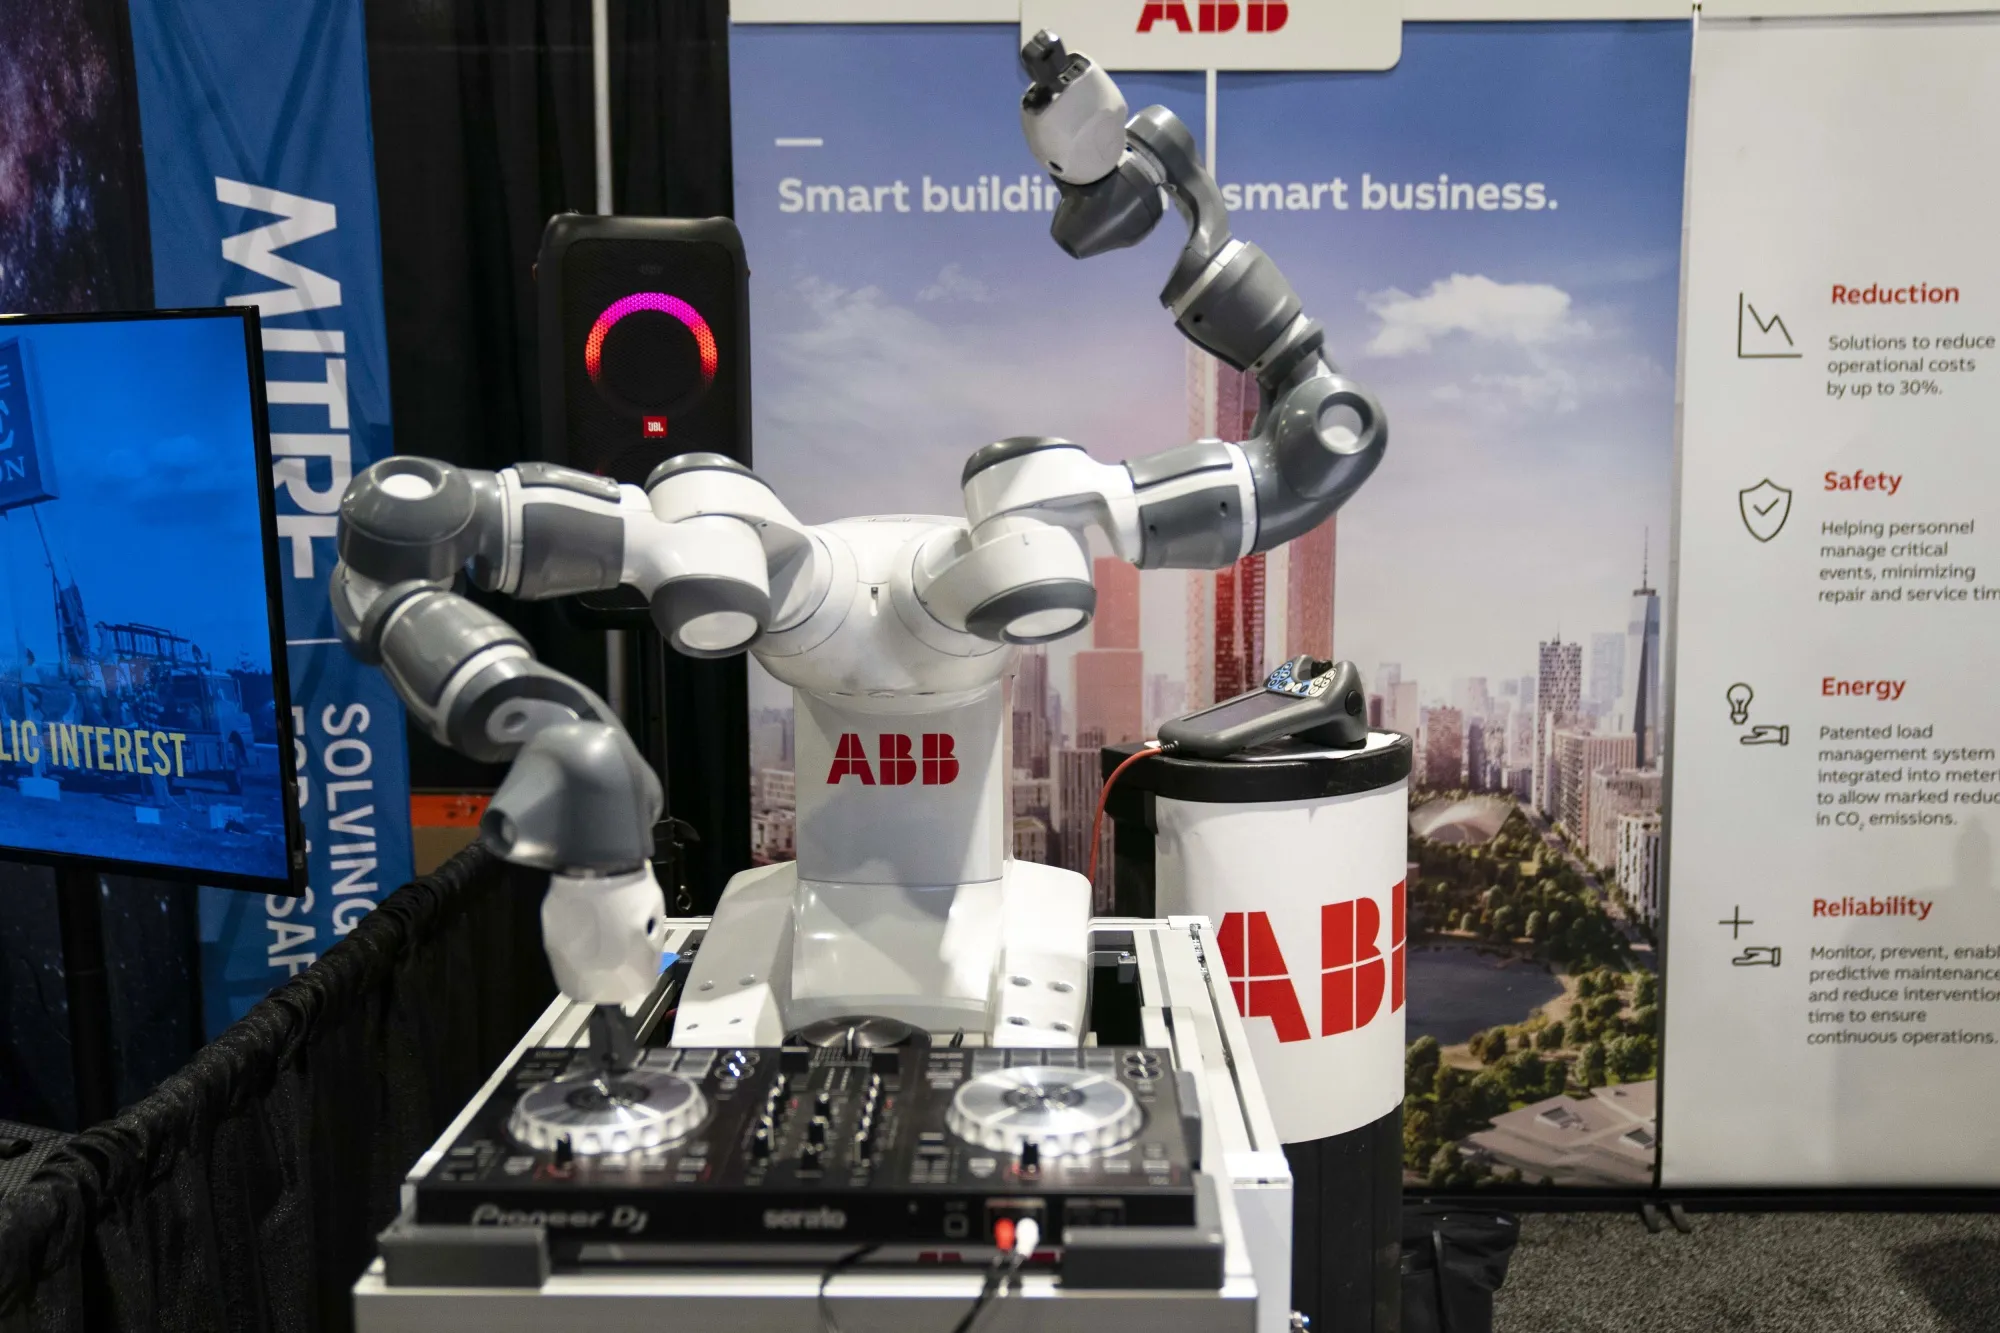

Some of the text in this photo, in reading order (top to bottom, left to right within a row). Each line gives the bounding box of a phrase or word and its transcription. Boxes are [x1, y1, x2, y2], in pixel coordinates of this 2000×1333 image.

[778, 178, 911, 213] Smart
[1221, 177, 1348, 211] smart
[1361, 173, 1558, 211] business.
[1831, 282, 1959, 304] Reduction
[1829, 333, 1995, 351] Solutions to reduce
[1828, 357, 1975, 376] operational costs
[1827, 379, 1942, 399] by up to 30%.
[647, 421, 664, 432] JBL
[1824, 470, 1902, 496] Safety
[1822, 519, 1974, 539] Helping personnel
[1820, 541, 1948, 561] manage critical
[1819, 564, 1976, 582] events, minimizing
[1819, 587, 1866, 604] repair
[1870, 586, 1902, 601] and
[1907, 586, 1968, 601] service
[1822, 677, 1906, 701] Energy
[1820, 724, 1933, 740] Patented load
[50, 722, 186, 777] INTEREST
[826, 733, 960, 785] ABB
[1818, 747, 1995, 764] management system
[1818, 767, 1902, 786] integrated
[1908, 768, 1941, 782] into
[1817, 792, 1834, 805] to
[1838, 790, 1880, 805] allow
[1885, 789, 1948, 805] marked
[321, 703, 379, 936] SOLVING
[1816, 811, 1830, 826] in
[1869, 811, 1957, 826] emissions.
[1813, 896, 1933, 921] Reliability
[1216, 879, 1406, 1043] AB
[1811, 945, 1876, 962] Monitor,
[1880, 945, 1949, 962] prevent,
[1809, 966, 1890, 985] predictive
[1808, 987, 1838, 1003] and
[1843, 987, 1899, 1002] reduce
[1808, 1009, 1927, 1024] time to ensure
[1807, 1029, 1998, 1047] continuous operations.
